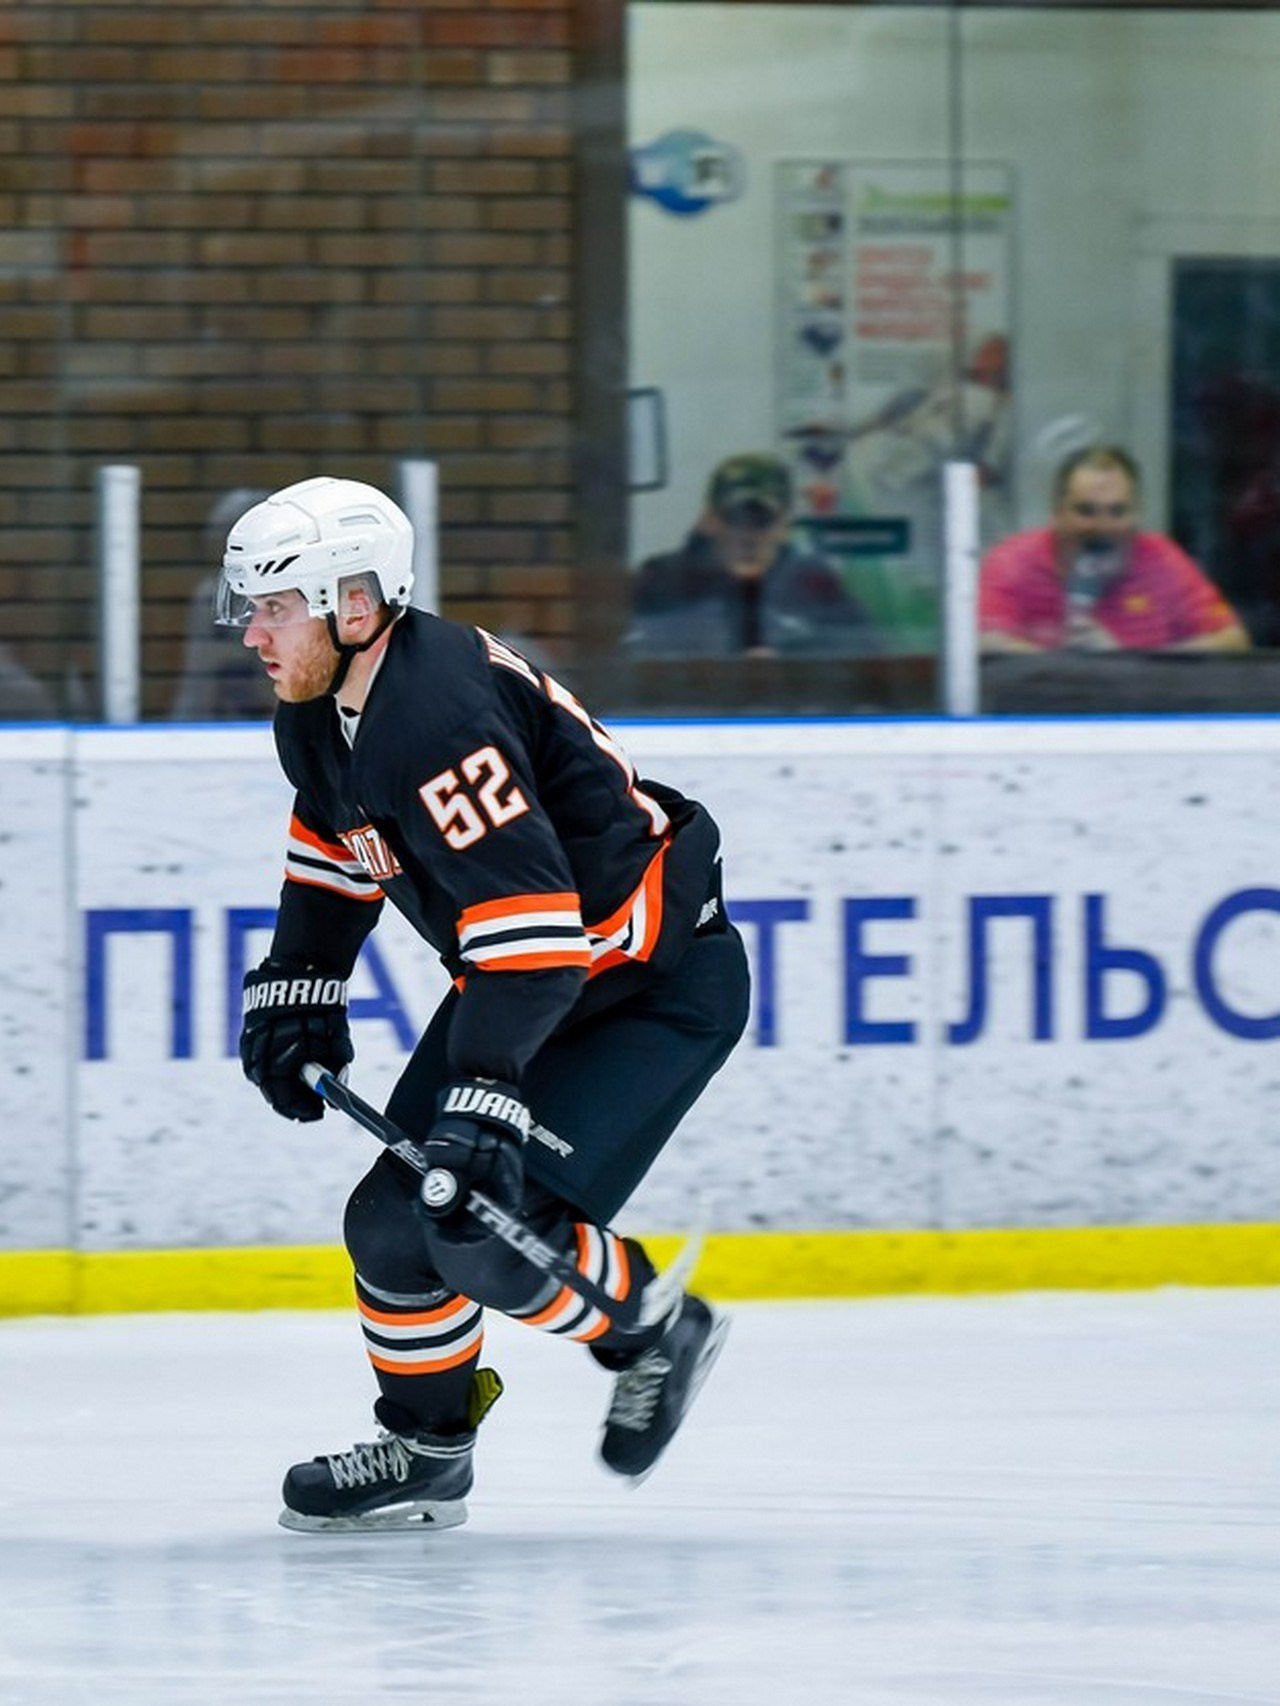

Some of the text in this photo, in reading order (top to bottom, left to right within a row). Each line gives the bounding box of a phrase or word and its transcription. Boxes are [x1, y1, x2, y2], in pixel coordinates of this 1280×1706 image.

[418, 746, 530, 850] 52
[86, 888, 1280, 1063] ПАТЕЛЬС
[466, 1190, 560, 1270] TRUE
